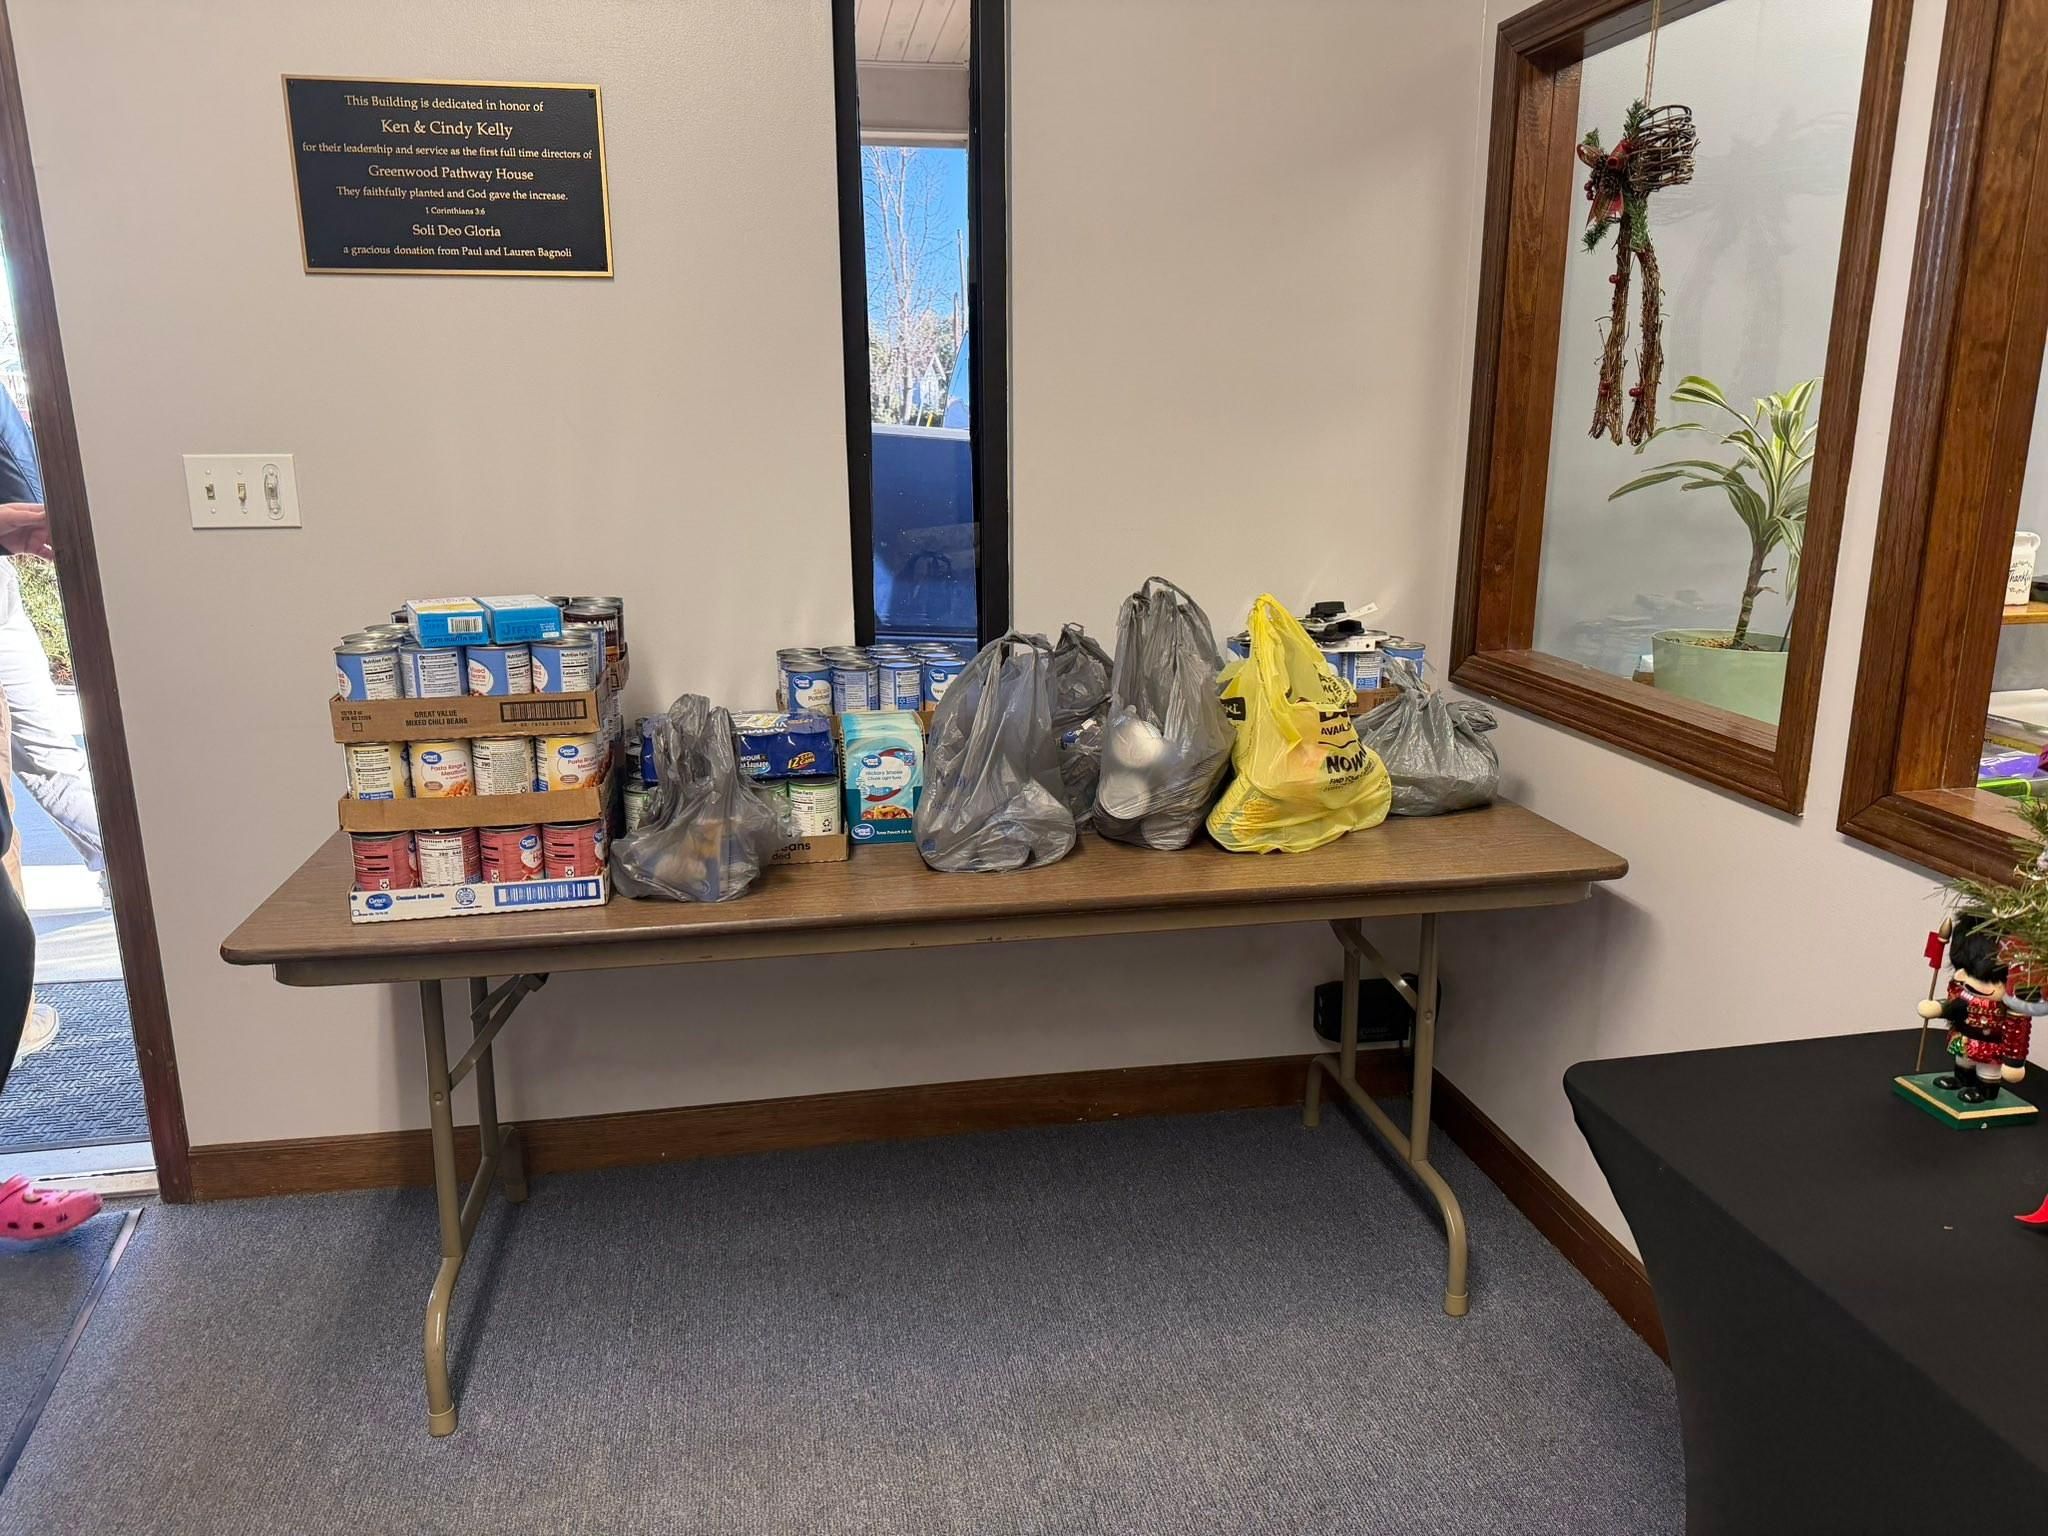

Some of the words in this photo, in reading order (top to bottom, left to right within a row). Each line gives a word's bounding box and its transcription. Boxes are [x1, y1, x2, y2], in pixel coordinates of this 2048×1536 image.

[343, 95, 369, 106] This
[371, 96, 418, 111] Building
[420, 97, 430, 108] is
[431, 98, 483, 110] dedicated
[486, 99, 497, 110] in
[500, 100, 531, 111] honor
[533, 101, 544, 112] of
[381, 119, 410, 133] Ken
[413, 120, 426, 134] &
[430, 120, 473, 139] Cindy
[477, 122, 513, 140] Kelly
[302, 141, 316, 152] for
[318, 142, 342, 153] their
[343, 143, 393, 156] leadership
[395, 144, 413, 155] and
[415, 145, 448, 155] service
[450, 148, 460, 156] as
[462, 146, 477, 156] the
[479, 147, 498, 156] first
[500, 147, 516, 157] full
[518, 148, 539, 158] time
[541, 148, 581, 159] directors
[583, 149, 593, 159] of
[368, 164, 439, 178] Greenwood
[441, 166, 493, 182] Pathway
[496, 168, 534, 180] House
[336, 186, 360, 199] They
[363, 186, 407, 199] faithfully
[409, 187, 445, 199] planted
[446, 188, 464, 198] and
[466, 189, 487, 199] God
[489, 192, 510, 202] gave
[512, 190, 527, 200] the
[529, 190, 569, 201] increase.
[425, 206, 430, 214] 1
[431, 206, 474, 215] Corinthians
[412, 224, 435, 236] Soli
[438, 225, 462, 236] Deo
[464, 225, 501, 237] Gloria
[343, 246, 349, 254] a
[351, 245, 391, 256] gracious
[393, 245, 435, 255] donation
[437, 246, 460, 256] from
[461, 247, 482, 256] Paul
[484, 247, 501, 256] and
[503, 247, 536, 257] Lauren
[537, 248, 573, 259] Bagnoli
[414, 710, 436, 718] GREAT
[405, 719, 427, 727] MIXED
[428, 718, 446, 726] CHILI
